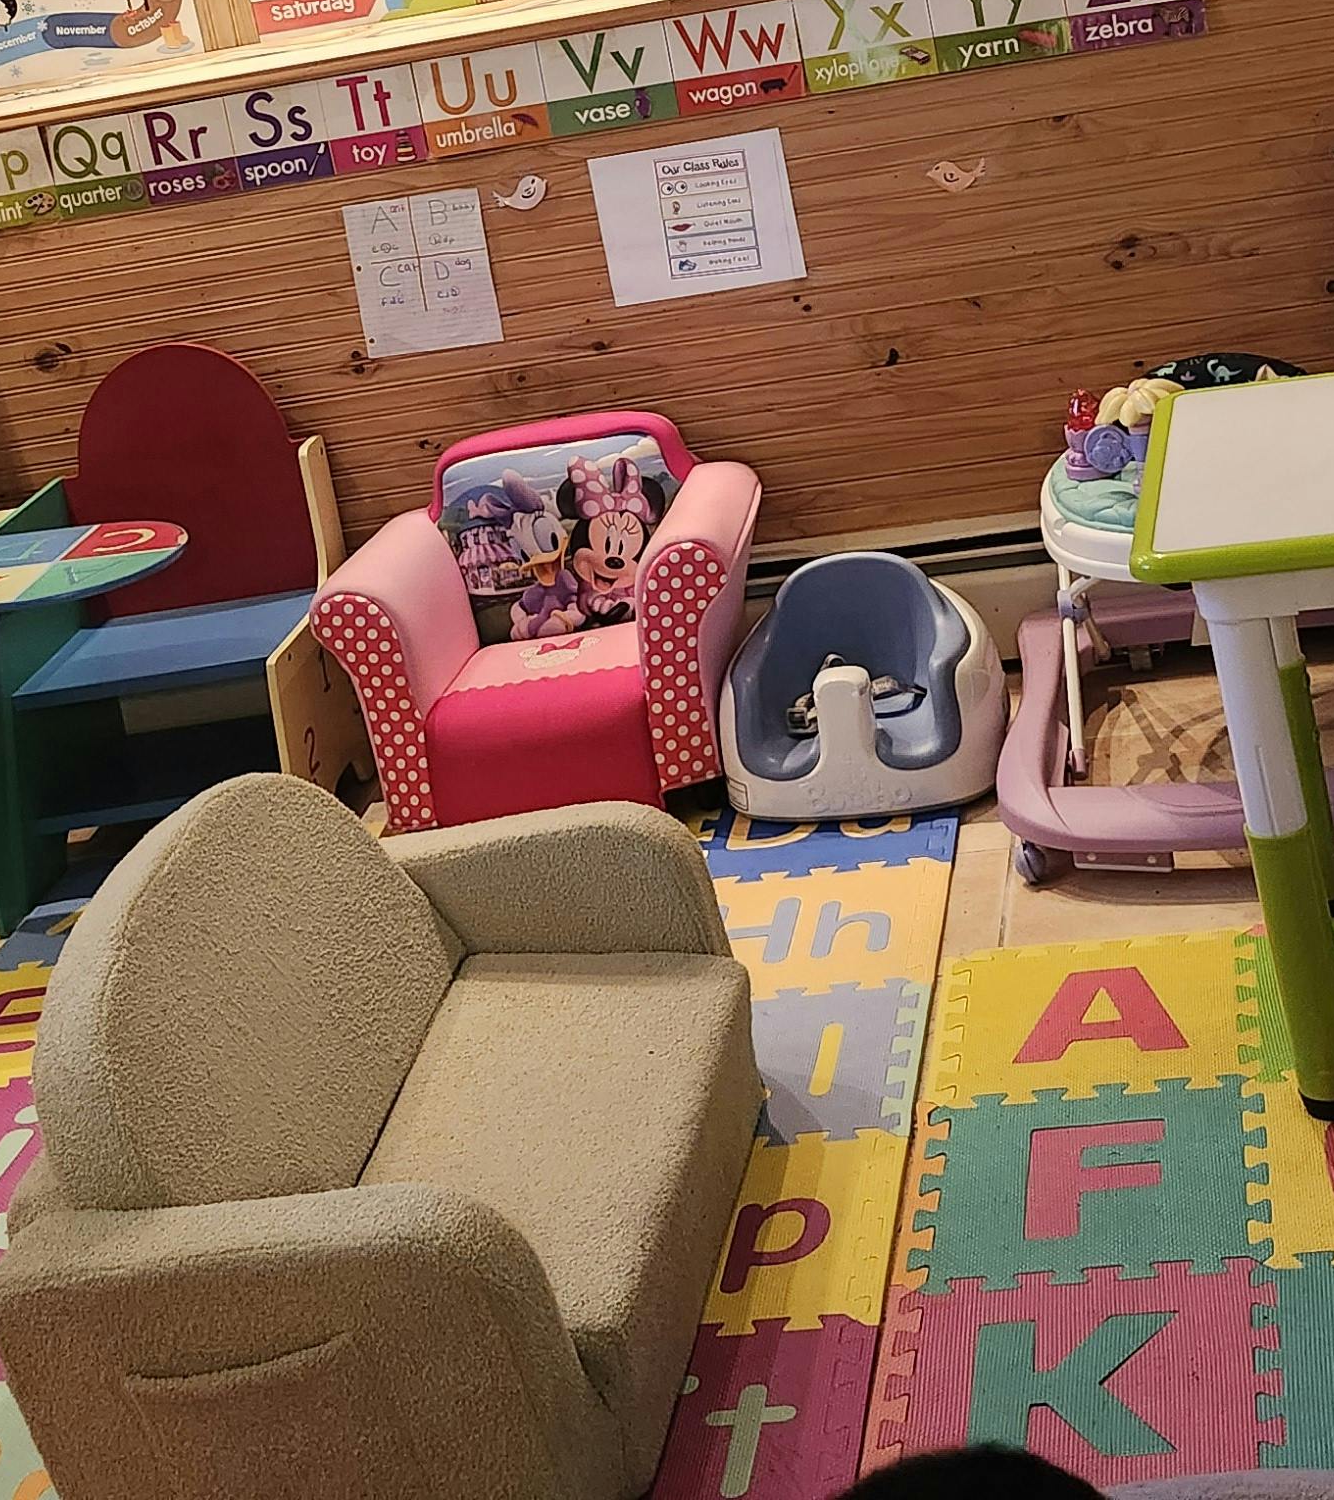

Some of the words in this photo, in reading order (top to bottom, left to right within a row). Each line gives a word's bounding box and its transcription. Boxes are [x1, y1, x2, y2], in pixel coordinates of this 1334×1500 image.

[55, 24, 108, 37] November
[126, 7, 165, 37] October
[1085, 13, 1153, 42] zebra
[957, 35, 1021, 69] yarn
[688, 79, 758, 106] wagon
[244, 90, 313, 148] Ss
[574, 100, 631, 126] vase
[434, 115, 517, 149] umbrella
[351, 142, 388, 166] toy
[661, 164, 680, 176] Our
[683, 160, 710, 173] Class
[711, 157, 740, 169] Rules
[148, 172, 207, 198] roses
[243, 156, 308, 186] spoon
[58, 178, 124, 214] quarter
[454, 257, 472, 271] dog
[1010, 965, 1192, 1067] A
[1022, 1117, 1166, 1242] F
